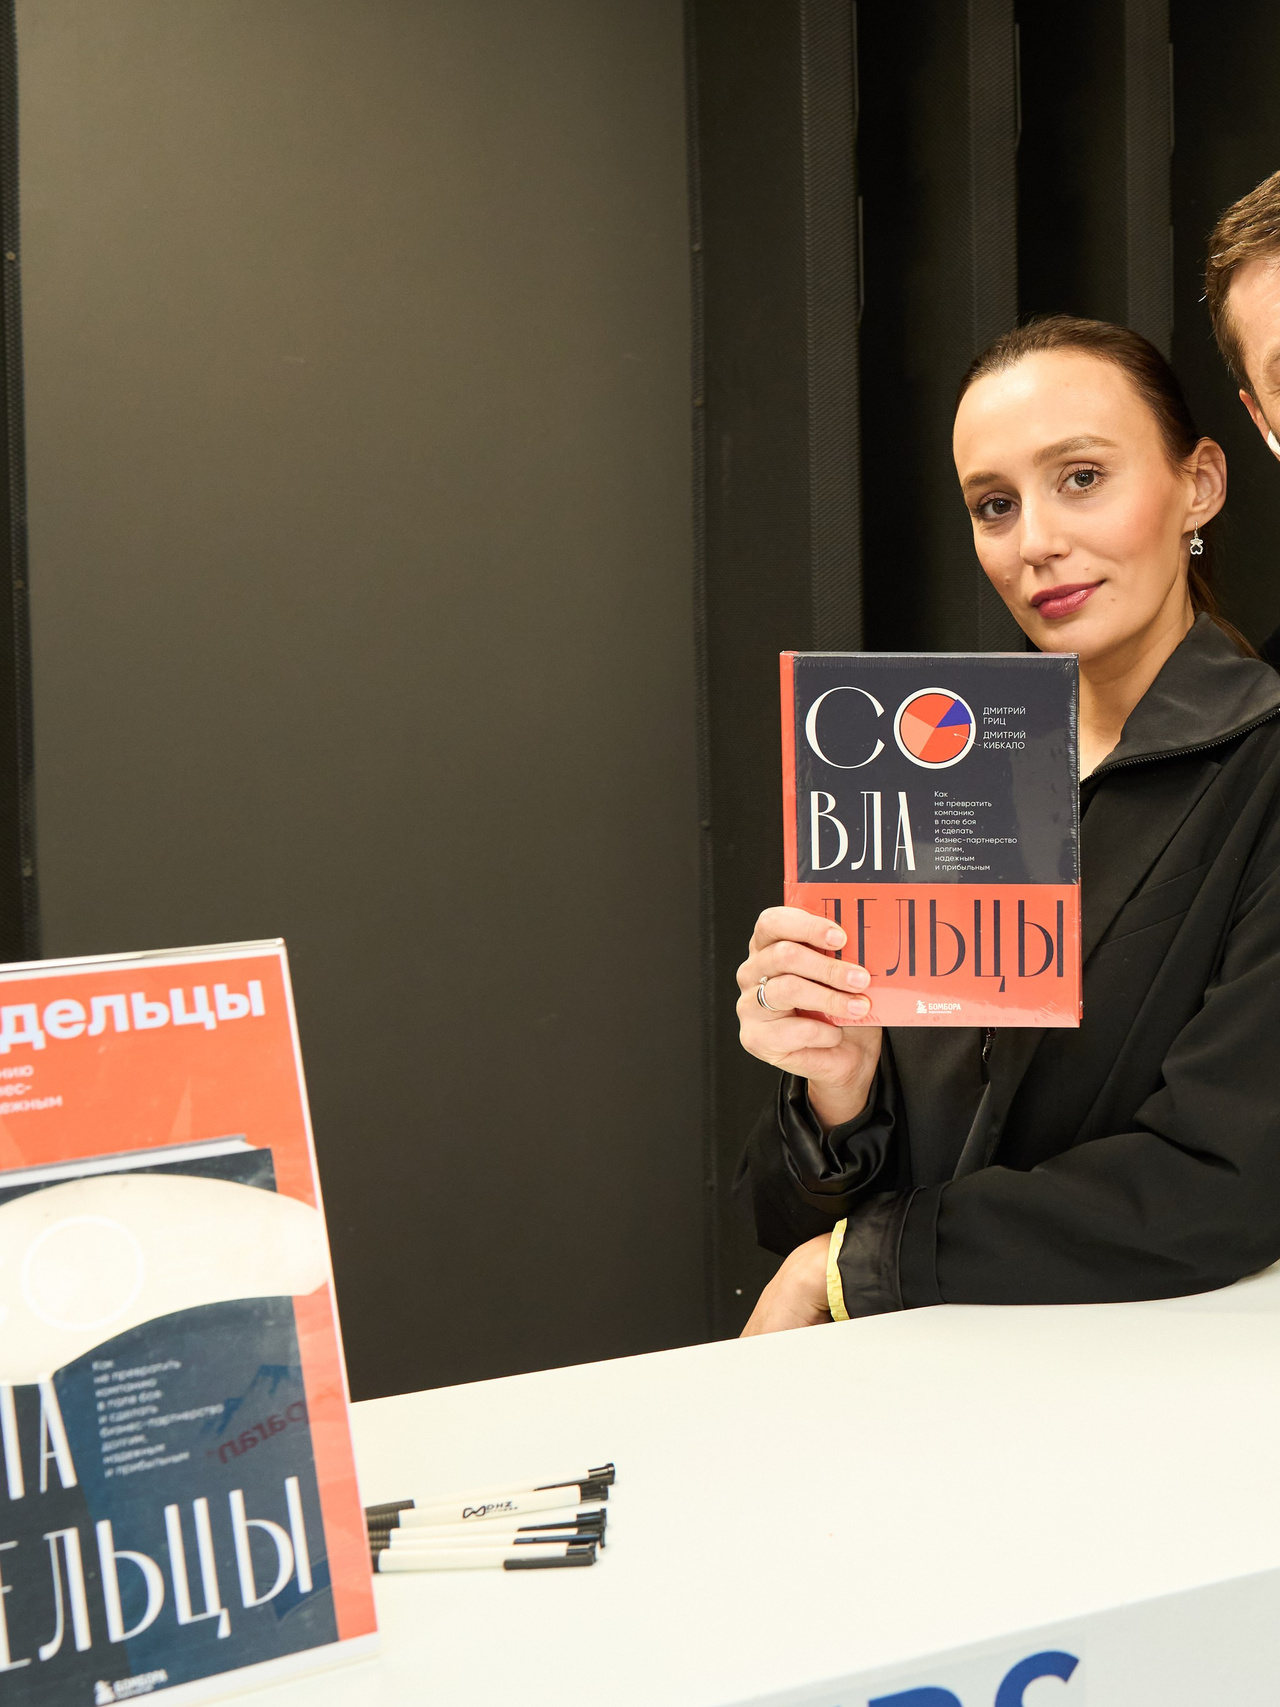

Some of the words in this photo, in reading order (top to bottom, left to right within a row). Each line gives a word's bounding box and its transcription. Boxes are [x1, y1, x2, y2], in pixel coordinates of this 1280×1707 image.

[983, 706, 1026, 715] ДМИТРИЙ
[983, 717, 1006, 726] ГРИЦ
[983, 730, 1026, 740] ДМИТРИЙ
[983, 741, 1026, 750] КИБКАЛО
[934, 790, 949, 798] Как
[810, 791, 916, 871] ВЛА
[934, 836, 1018, 845] бизнес-партнерство
[942, 864, 991, 872] прибыльным
[928, 1002, 962, 1011] БОМБОРА
[0, 1064, 34, 1079] нию
